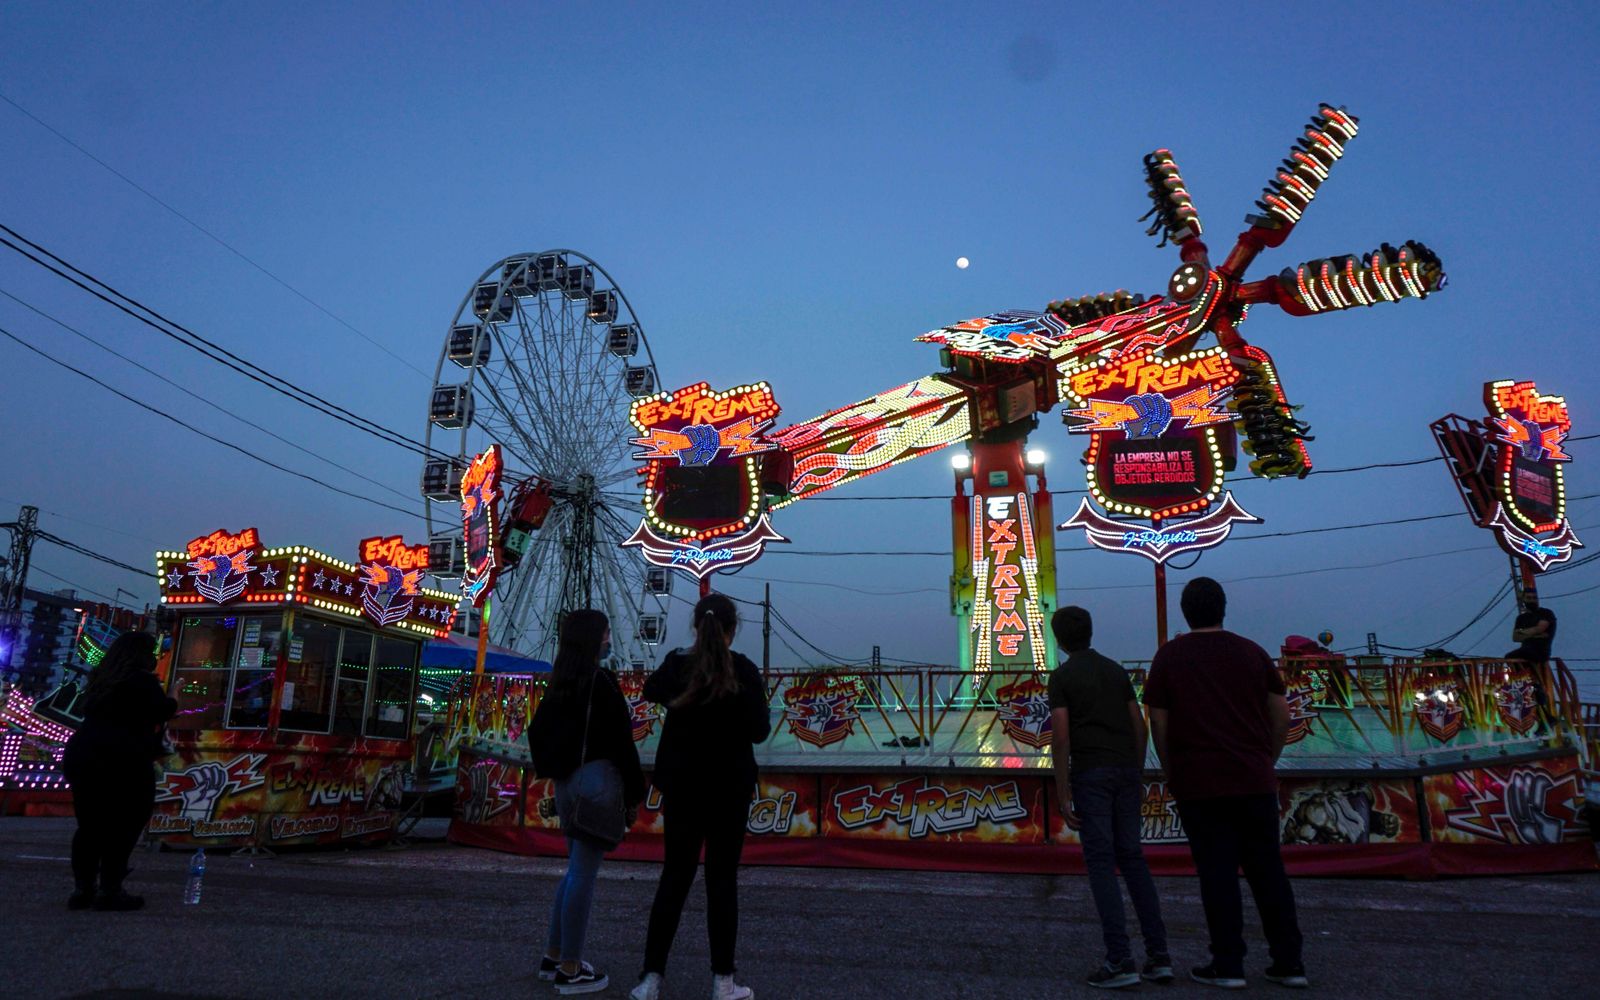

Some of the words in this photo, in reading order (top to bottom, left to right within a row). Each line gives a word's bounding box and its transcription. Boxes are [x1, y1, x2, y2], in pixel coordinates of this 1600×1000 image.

[1070, 355, 1228, 395] EXTREME
[637, 391, 768, 425] EXTREME
[1496, 387, 1567, 423] EXTREME
[1113, 461, 1183, 474] RESPONSABILIZA
[1184, 460, 1196, 472] DE
[1114, 453, 1126, 464] LA
[1127, 451, 1166, 463] EMPRESA
[1167, 451, 1179, 462] NO
[1181, 450, 1193, 461] SE
[1114, 473, 1152, 484] OBJETOS
[1153, 472, 1196, 484] PERDIDOS
[188, 531, 255, 558] EXTREME
[366, 538, 429, 568] EXTREME
[986, 495, 1028, 656] EXTREME
[271, 761, 365, 807] EXTREME
[834, 776, 1028, 837] EXTREME
